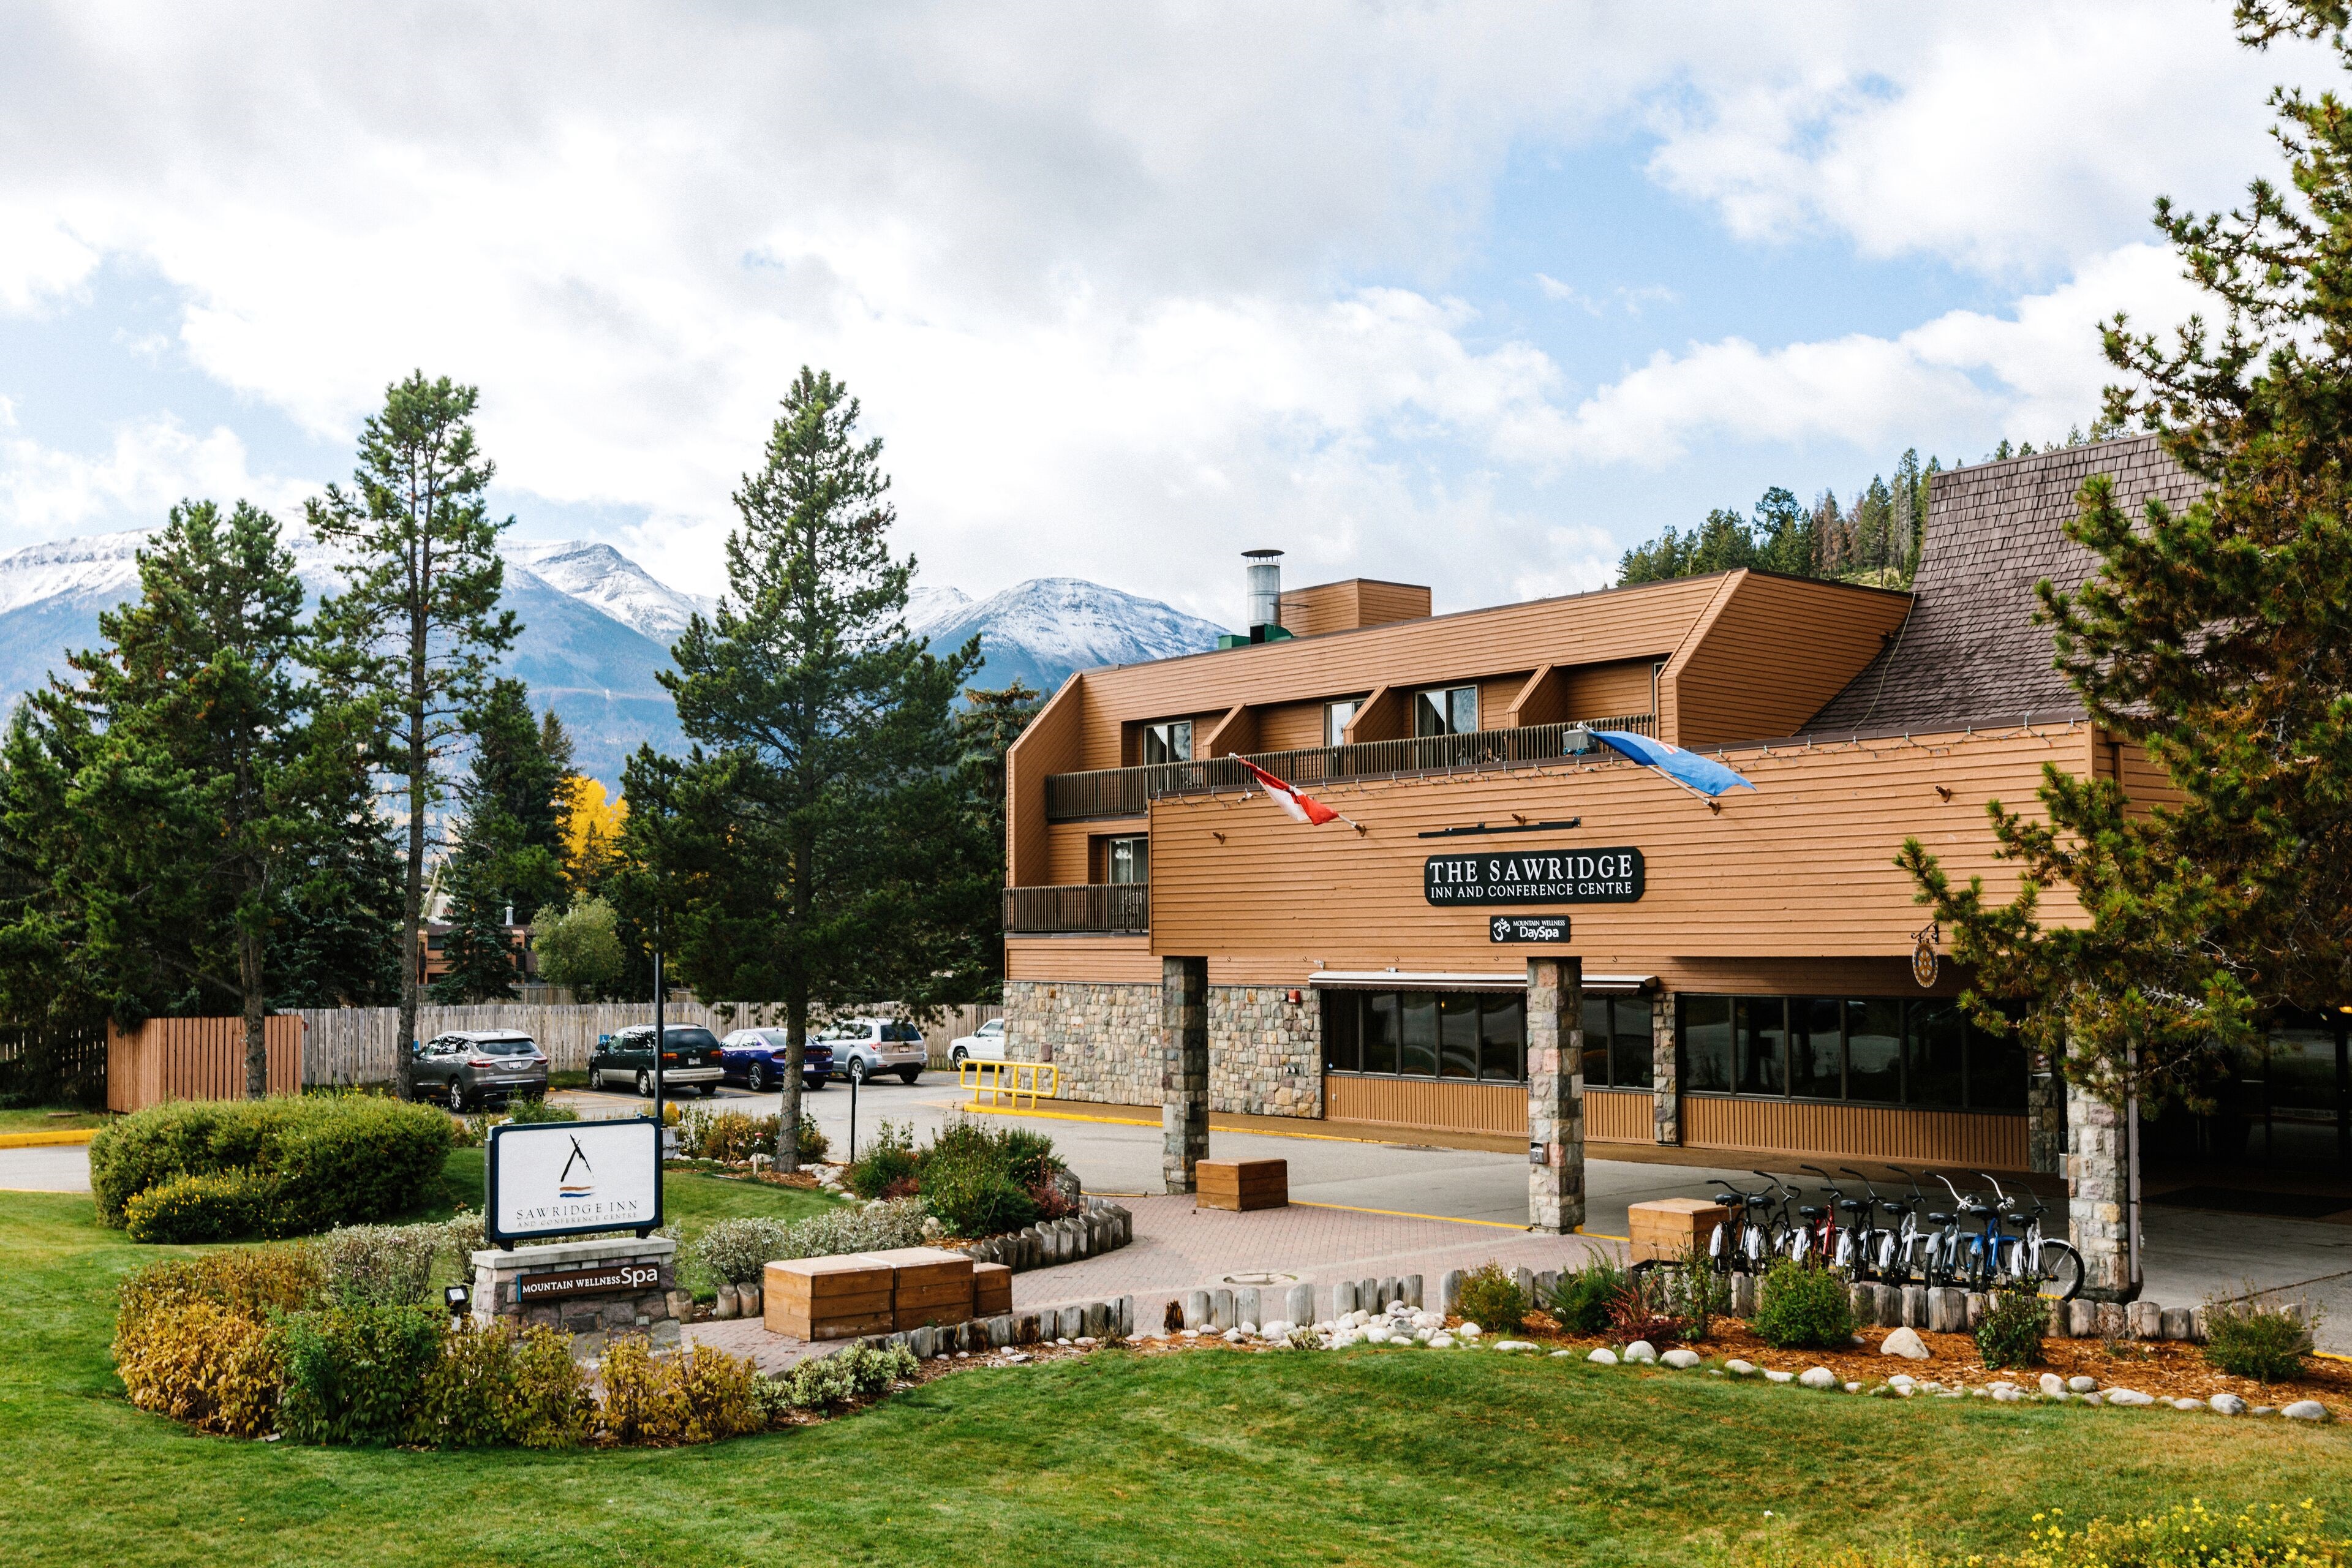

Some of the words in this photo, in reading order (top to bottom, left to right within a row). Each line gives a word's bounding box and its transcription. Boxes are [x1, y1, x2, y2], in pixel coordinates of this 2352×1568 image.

[1430, 861, 1478, 883] THE
[1490, 854, 1633, 882] SAWRIDGE
[1431, 886, 1452, 899] INN
[1457, 884, 1483, 897] AND
[1488, 883, 1574, 897] CONFERENCE
[1578, 882, 1632, 895] CENTRE
[1520, 926, 1559, 941] DaySpa
[516, 1203, 602, 1219] SAWRIDGE
[610, 1200, 637, 1212] INN
[540, 1215, 599, 1226] CONFERENCE
[603, 1212, 637, 1220] CENTRE
[522, 1280, 573, 1294] MOUNTAIN
[575, 1276, 620, 1288] WELLNESS
[620, 1267, 658, 1287] Spa
